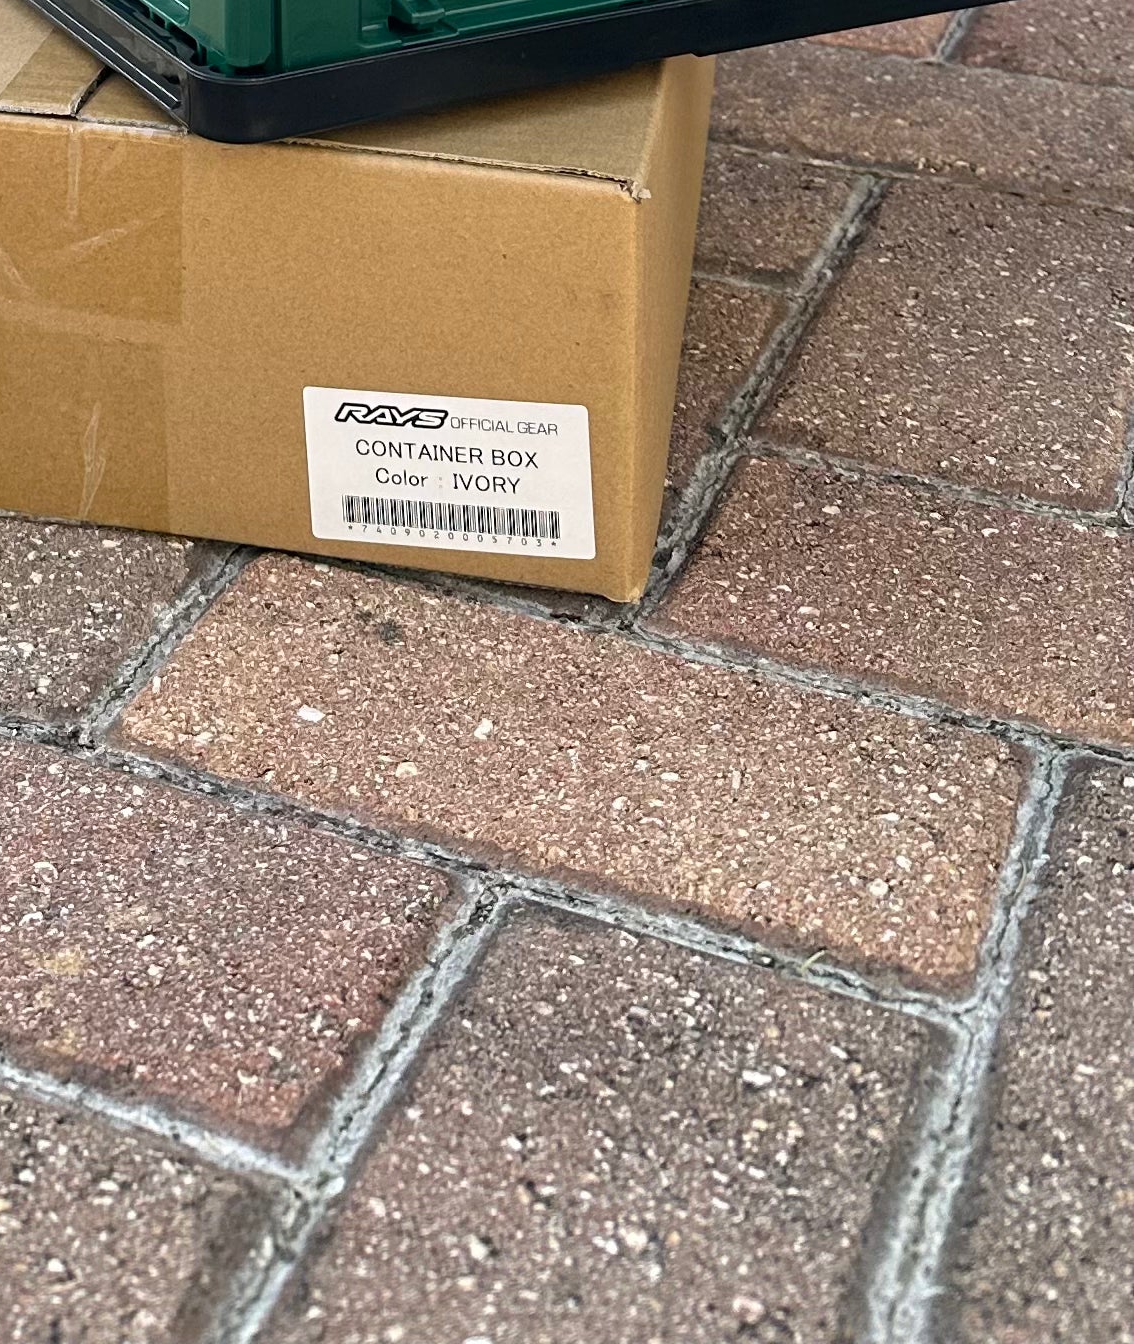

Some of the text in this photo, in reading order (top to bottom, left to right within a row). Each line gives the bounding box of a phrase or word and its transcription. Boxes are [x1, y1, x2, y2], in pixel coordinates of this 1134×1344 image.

[334, 402, 559, 435] RAYS OFFICIAL GEAR
[355, 439, 539, 469] CONTAINER BOX
[375, 467, 428, 487] Color
[452, 473, 522, 494] IVORY
